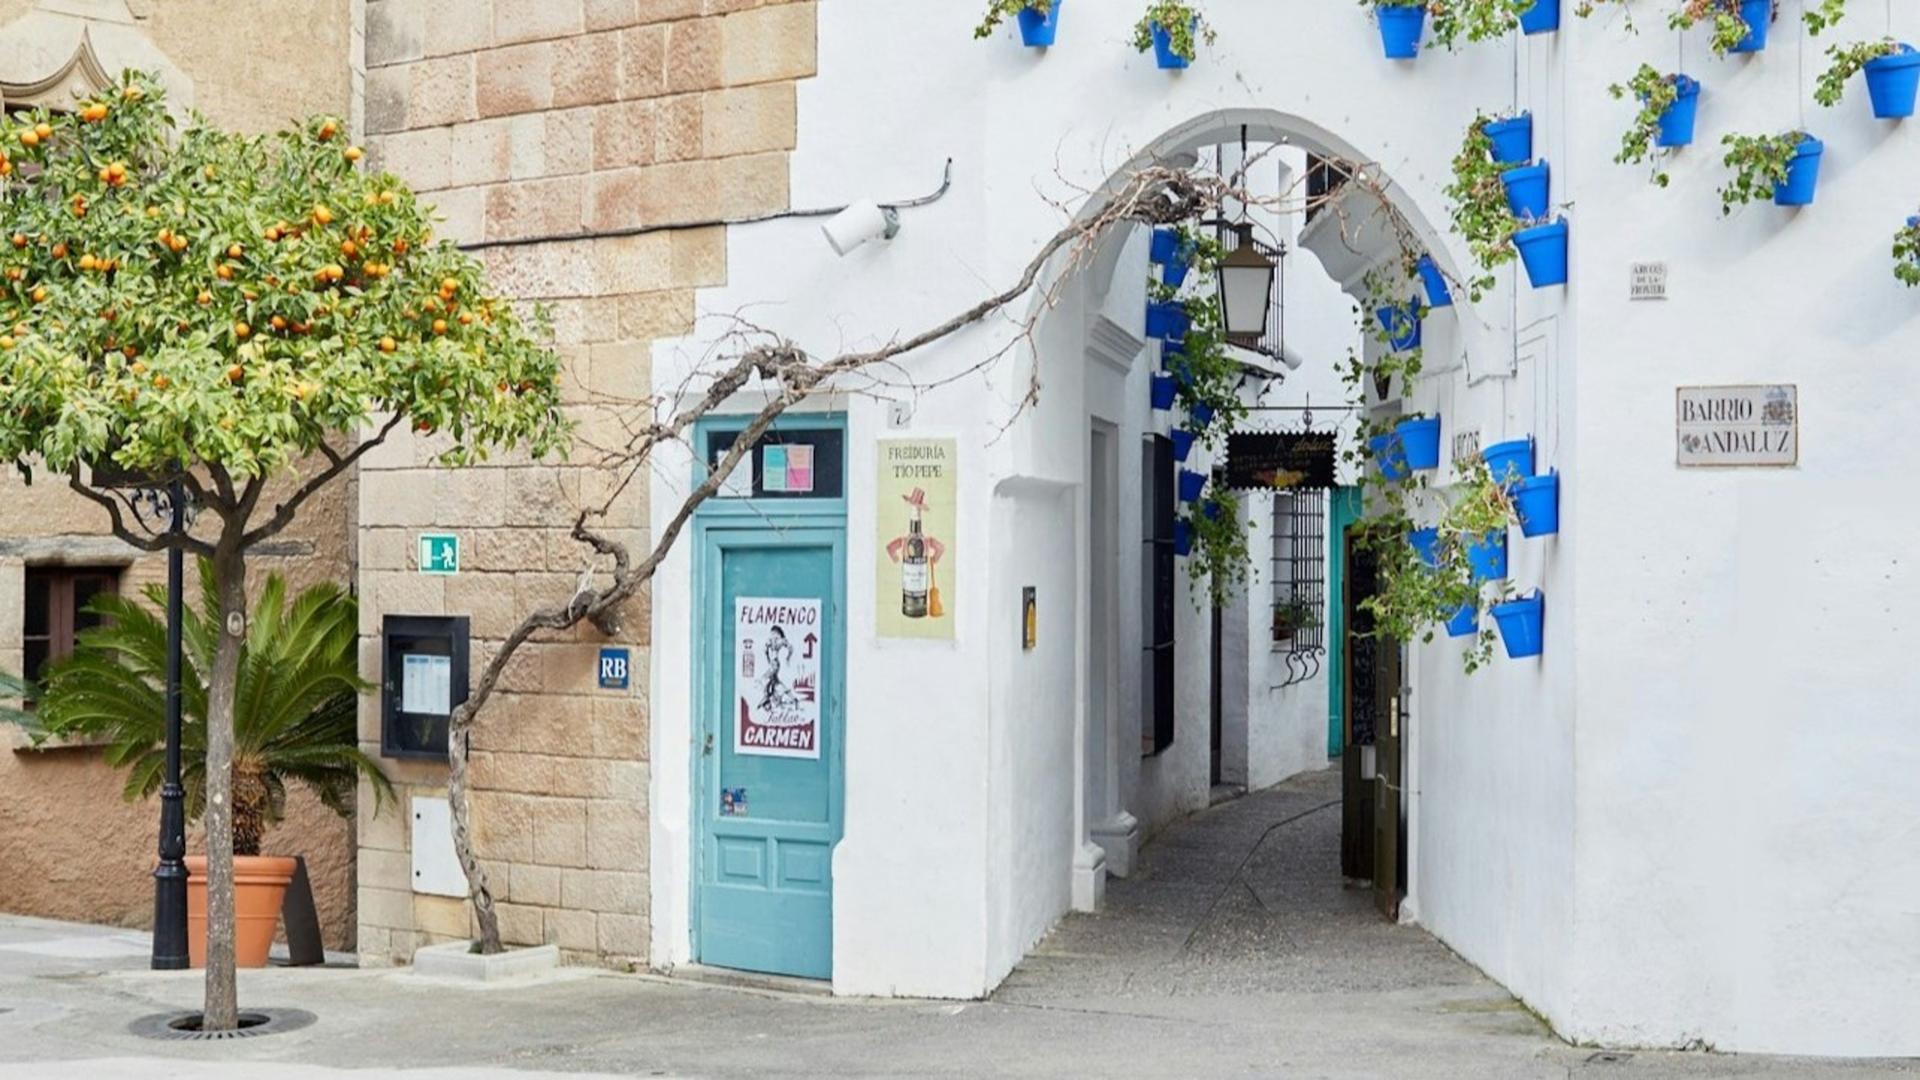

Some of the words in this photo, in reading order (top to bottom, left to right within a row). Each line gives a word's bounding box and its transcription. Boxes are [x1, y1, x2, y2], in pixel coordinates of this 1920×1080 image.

[1682, 398, 1753, 422] BARRIO
[1700, 431, 1789, 452] ANDALUZ
[915, 464, 942, 478] PEPE
[741, 605, 816, 625] FLAMENCO
[602, 657, 627, 678] RB
[744, 726, 811, 748] CARMEN
